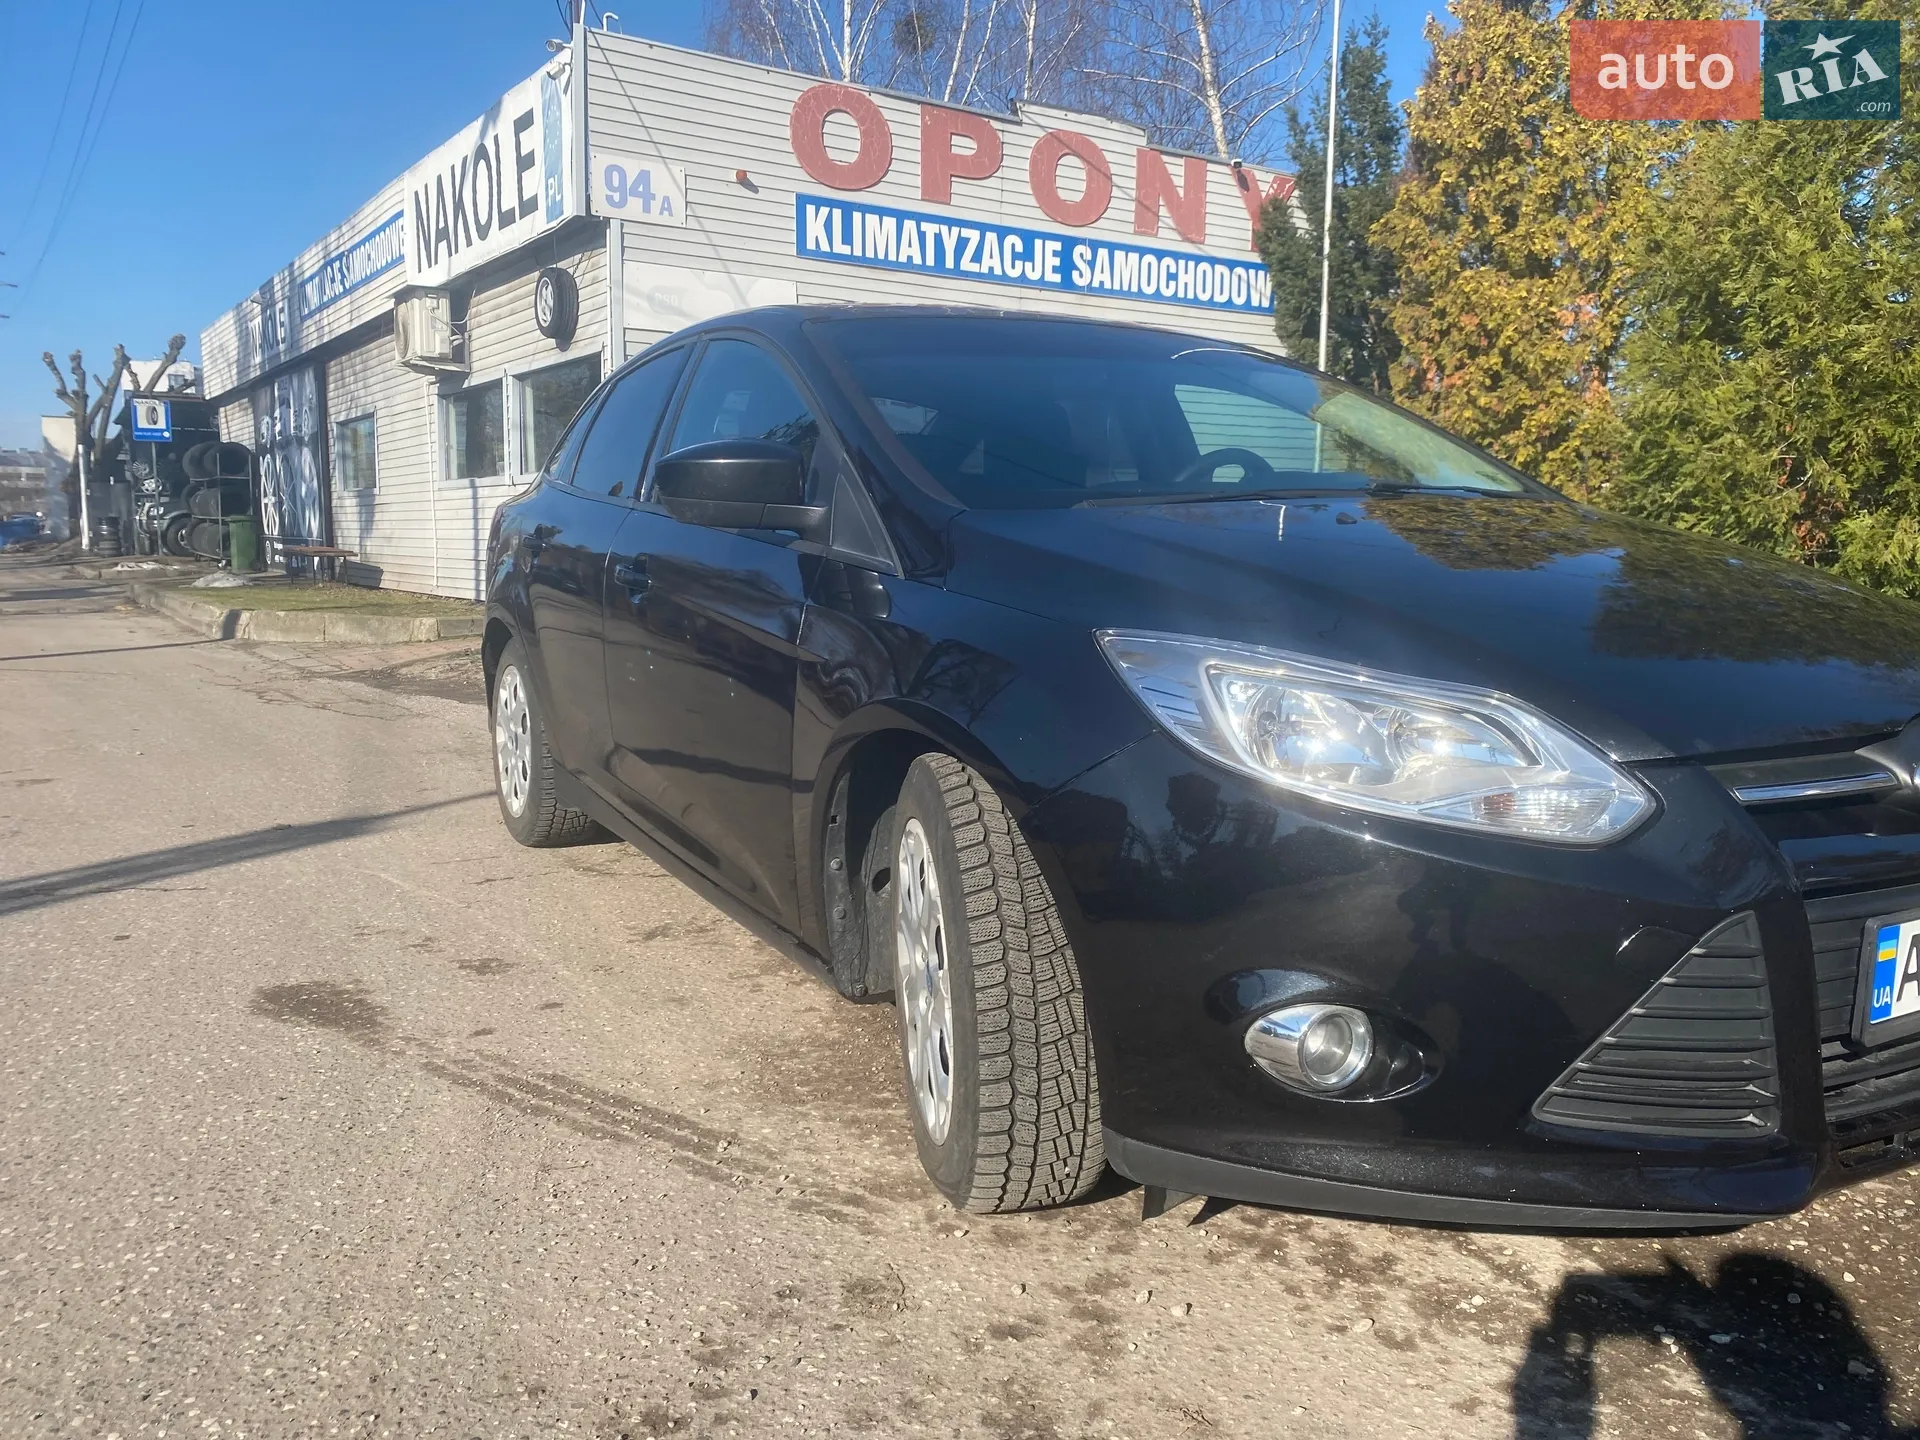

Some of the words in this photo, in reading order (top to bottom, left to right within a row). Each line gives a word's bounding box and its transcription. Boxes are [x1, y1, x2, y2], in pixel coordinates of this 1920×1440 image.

[414, 107, 539, 273] NAKOLE
[547, 174, 562, 207] PL
[789, 82, 1297, 252] OPONY
[805, 204, 1063, 283] KLIMATYZACJE
[1071, 244, 1276, 308] SAMOCHODOW
[250, 306, 287, 361] NAKOLE
[1873, 985, 1891, 1008] UA
